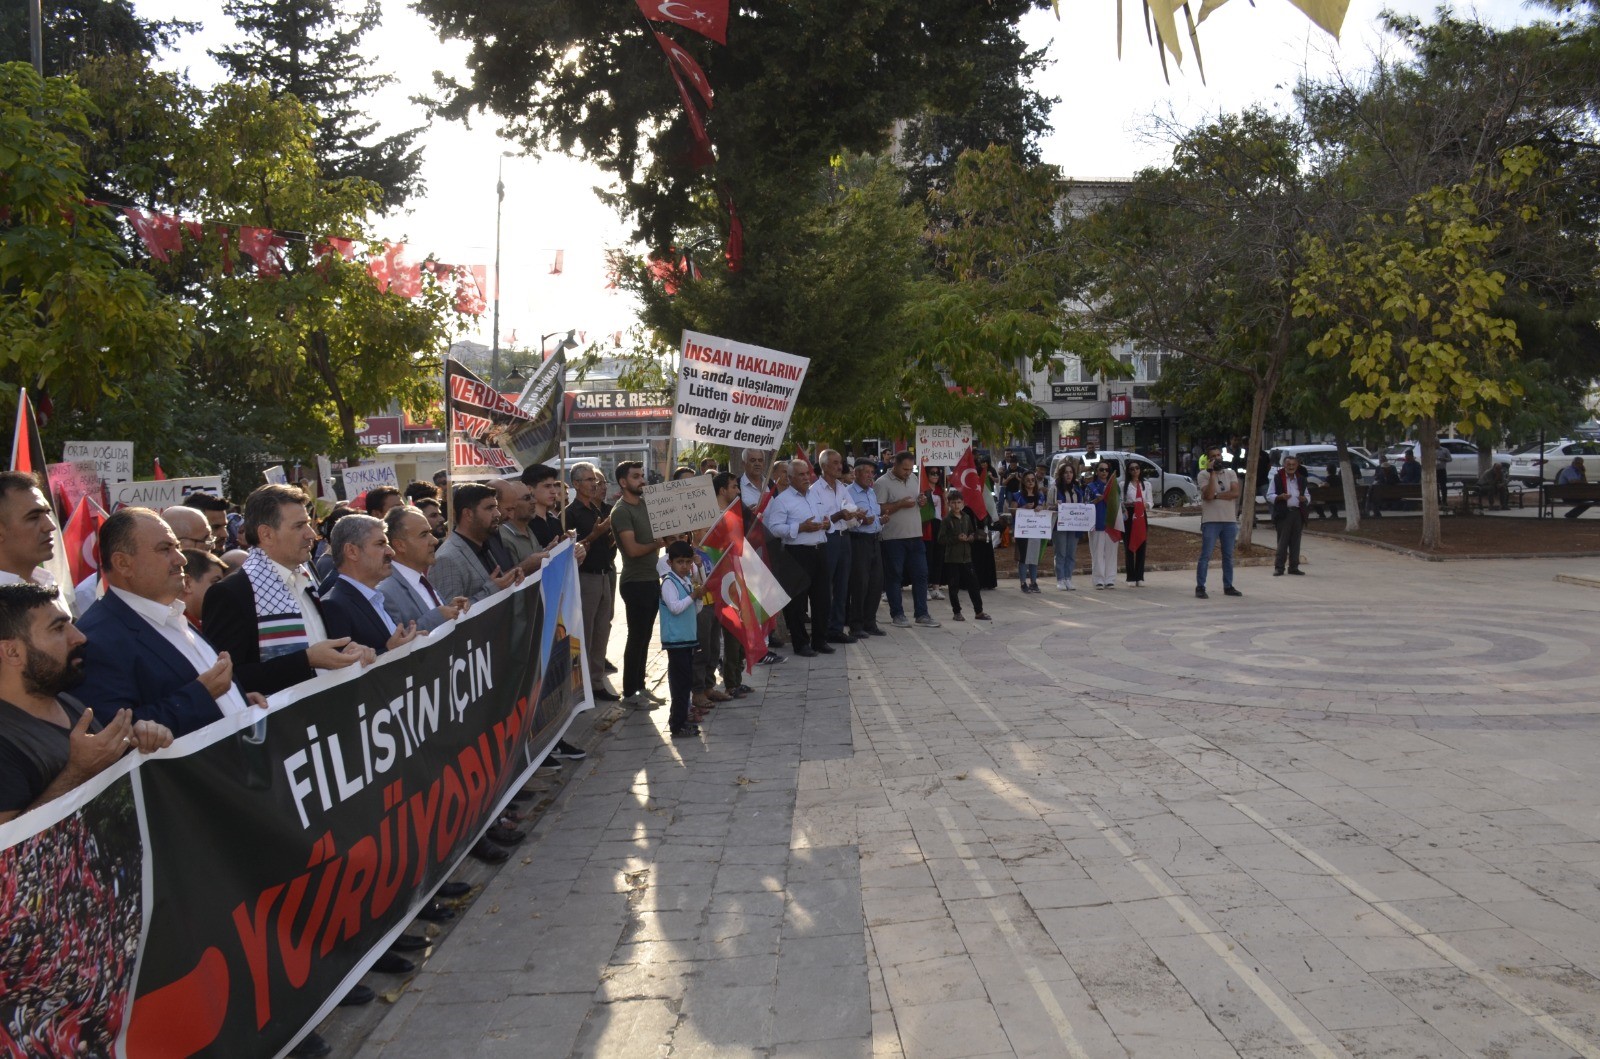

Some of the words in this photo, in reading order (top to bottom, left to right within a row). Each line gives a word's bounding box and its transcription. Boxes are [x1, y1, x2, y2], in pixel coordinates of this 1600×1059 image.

[684, 339, 733, 367] İNSAN
[683, 366, 698, 380] şu
[701, 369, 734, 386] anda
[529, 392, 539, 402] 10
[688, 382, 728, 402] Lütfen
[576, 393, 611, 409] CAFE
[615, 393, 626, 408] &
[1111, 396, 1126, 416] BİM
[677, 402, 731, 424] olmadığı
[733, 411, 750, 425] bir
[358, 432, 392, 445] NESİ
[695, 422, 732, 439] tekrar
[932, 428, 960, 438] BEBEK
[1060, 437, 1078, 446] BİM
[67, 445, 89, 457] ORTA
[118, 486, 176, 504] CANIM
[687, 509, 716, 524] YAKIN
[284, 675, 440, 830] FİLİSTİN
[449, 639, 493, 724] İÇİN
